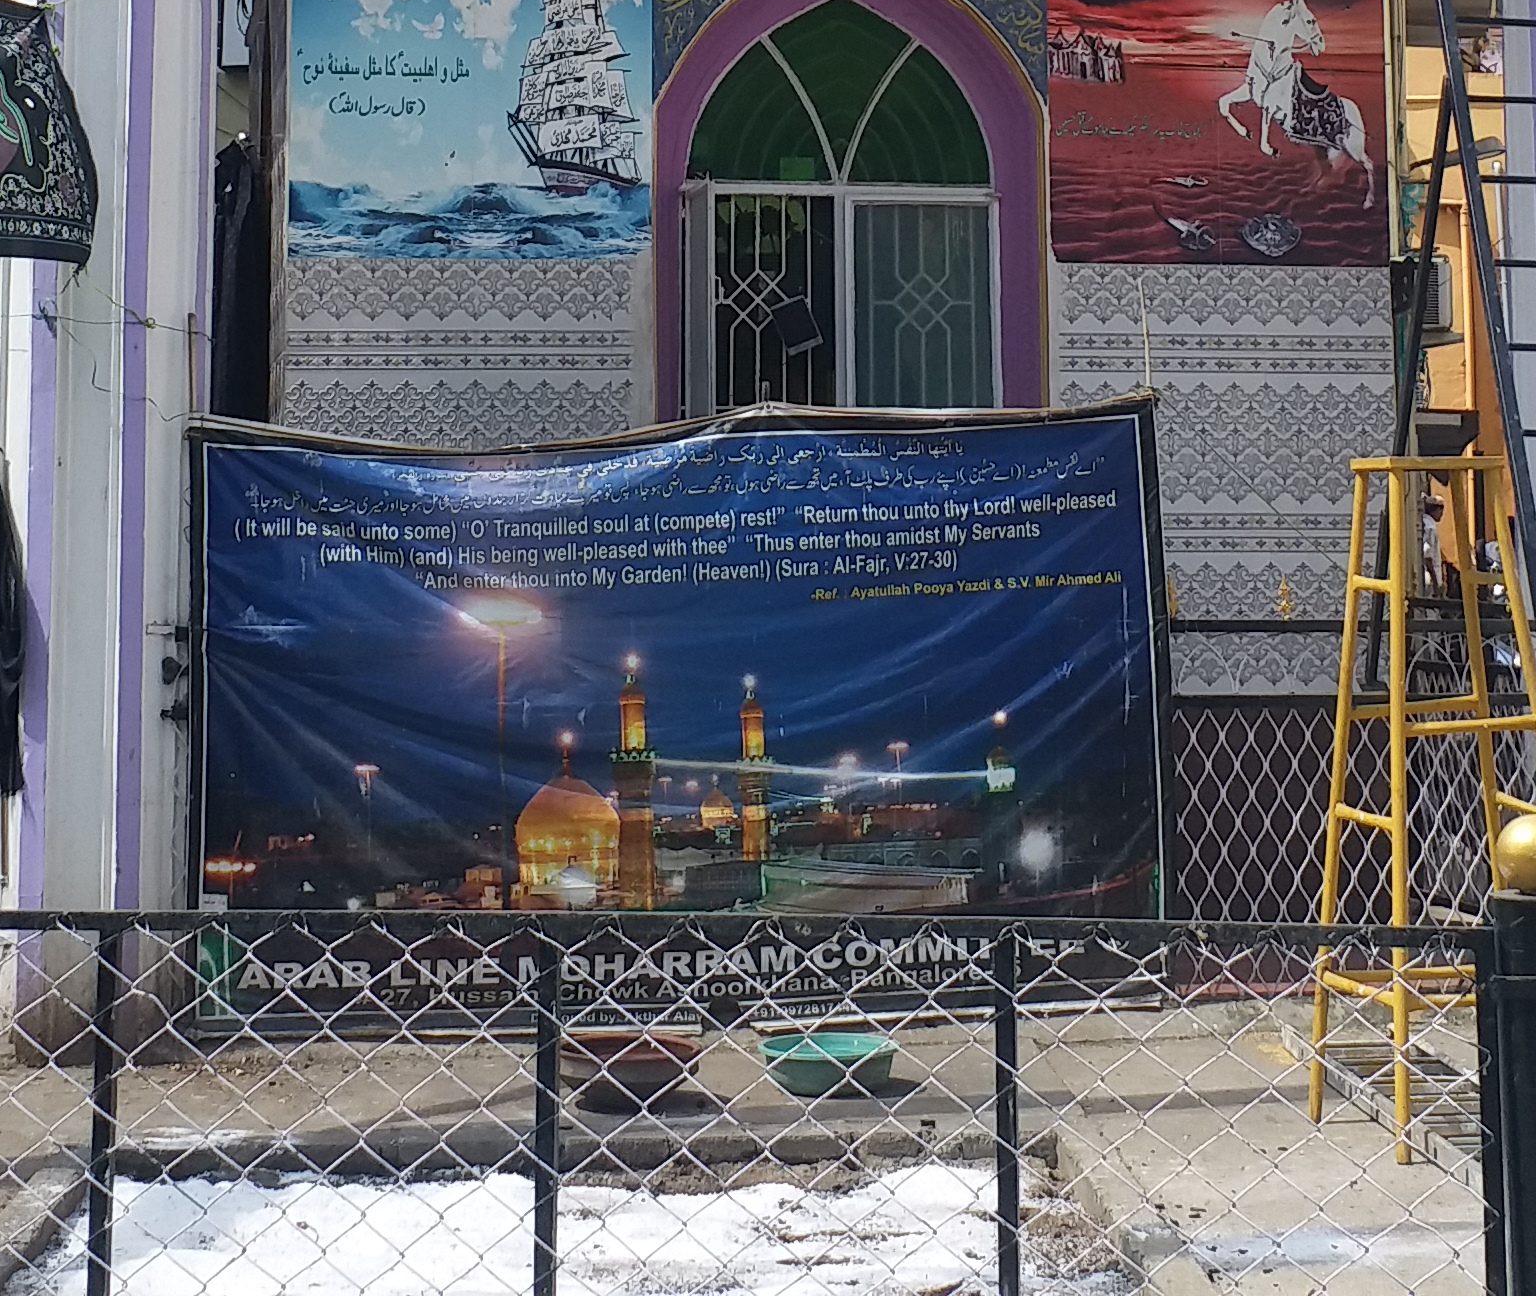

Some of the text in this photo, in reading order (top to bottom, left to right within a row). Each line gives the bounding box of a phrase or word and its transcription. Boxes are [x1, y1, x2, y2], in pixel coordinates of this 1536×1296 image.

[261, 518, 291, 537] will
[296, 518, 317, 536] be
[321, 521, 355, 539] said
[360, 524, 399, 541] unto
[404, 520, 457, 544] some)
[493, 516, 589, 543] Tranquilled
[593, 514, 629, 534] soul
[633, 515, 651, 532] at
[654, 510, 736, 536] (compete)
[862, 503, 899, 522] thou
[904, 500, 940, 519] unto
[943, 499, 969, 521] thy
[972, 496, 1016, 516] Lord!
[1019, 490, 1117, 515] well-pleased
[320, 544, 361, 567] (with
[366, 545, 404, 567] Him)
[409, 546, 453, 568] (and)
[458, 547, 485, 565] His
[490, 546, 539, 569] being
[543, 542, 648, 565] well-pleased
[652, 539, 687, 558] with
[799, 534, 840, 551] enter
[845, 530, 882, 549] thou
[885, 527, 940, 546] amidst
[944, 525, 967, 547] My
[971, 520, 1041, 542] Servants
[462, 572, 507, 589] enter
[511, 570, 549, 588] thou
[554, 569, 587, 588] into
[591, 566, 616, 590] My
[621, 563, 688, 584] Garden!
[692, 560, 771, 586] (Heaven!)
[775, 557, 820, 581] (Sura
[832, 553, 891, 577] Al-Fajr,
[850, 583, 911, 600] Ayatullah
[914, 581, 954, 597] Pooya
[956, 578, 991, 593] Yazdi
[993, 578, 1004, 591] &
[1034, 573, 1055, 588] Mir
[1056, 572, 1102, 587] Ahmed
[1104, 571, 1122, 585] Ali
[236, 960, 375, 990] ARAB
[389, 956, 501, 987] LINE
[429, 982, 540, 1006] Hussain
[560, 980, 652, 1001] Chowk
